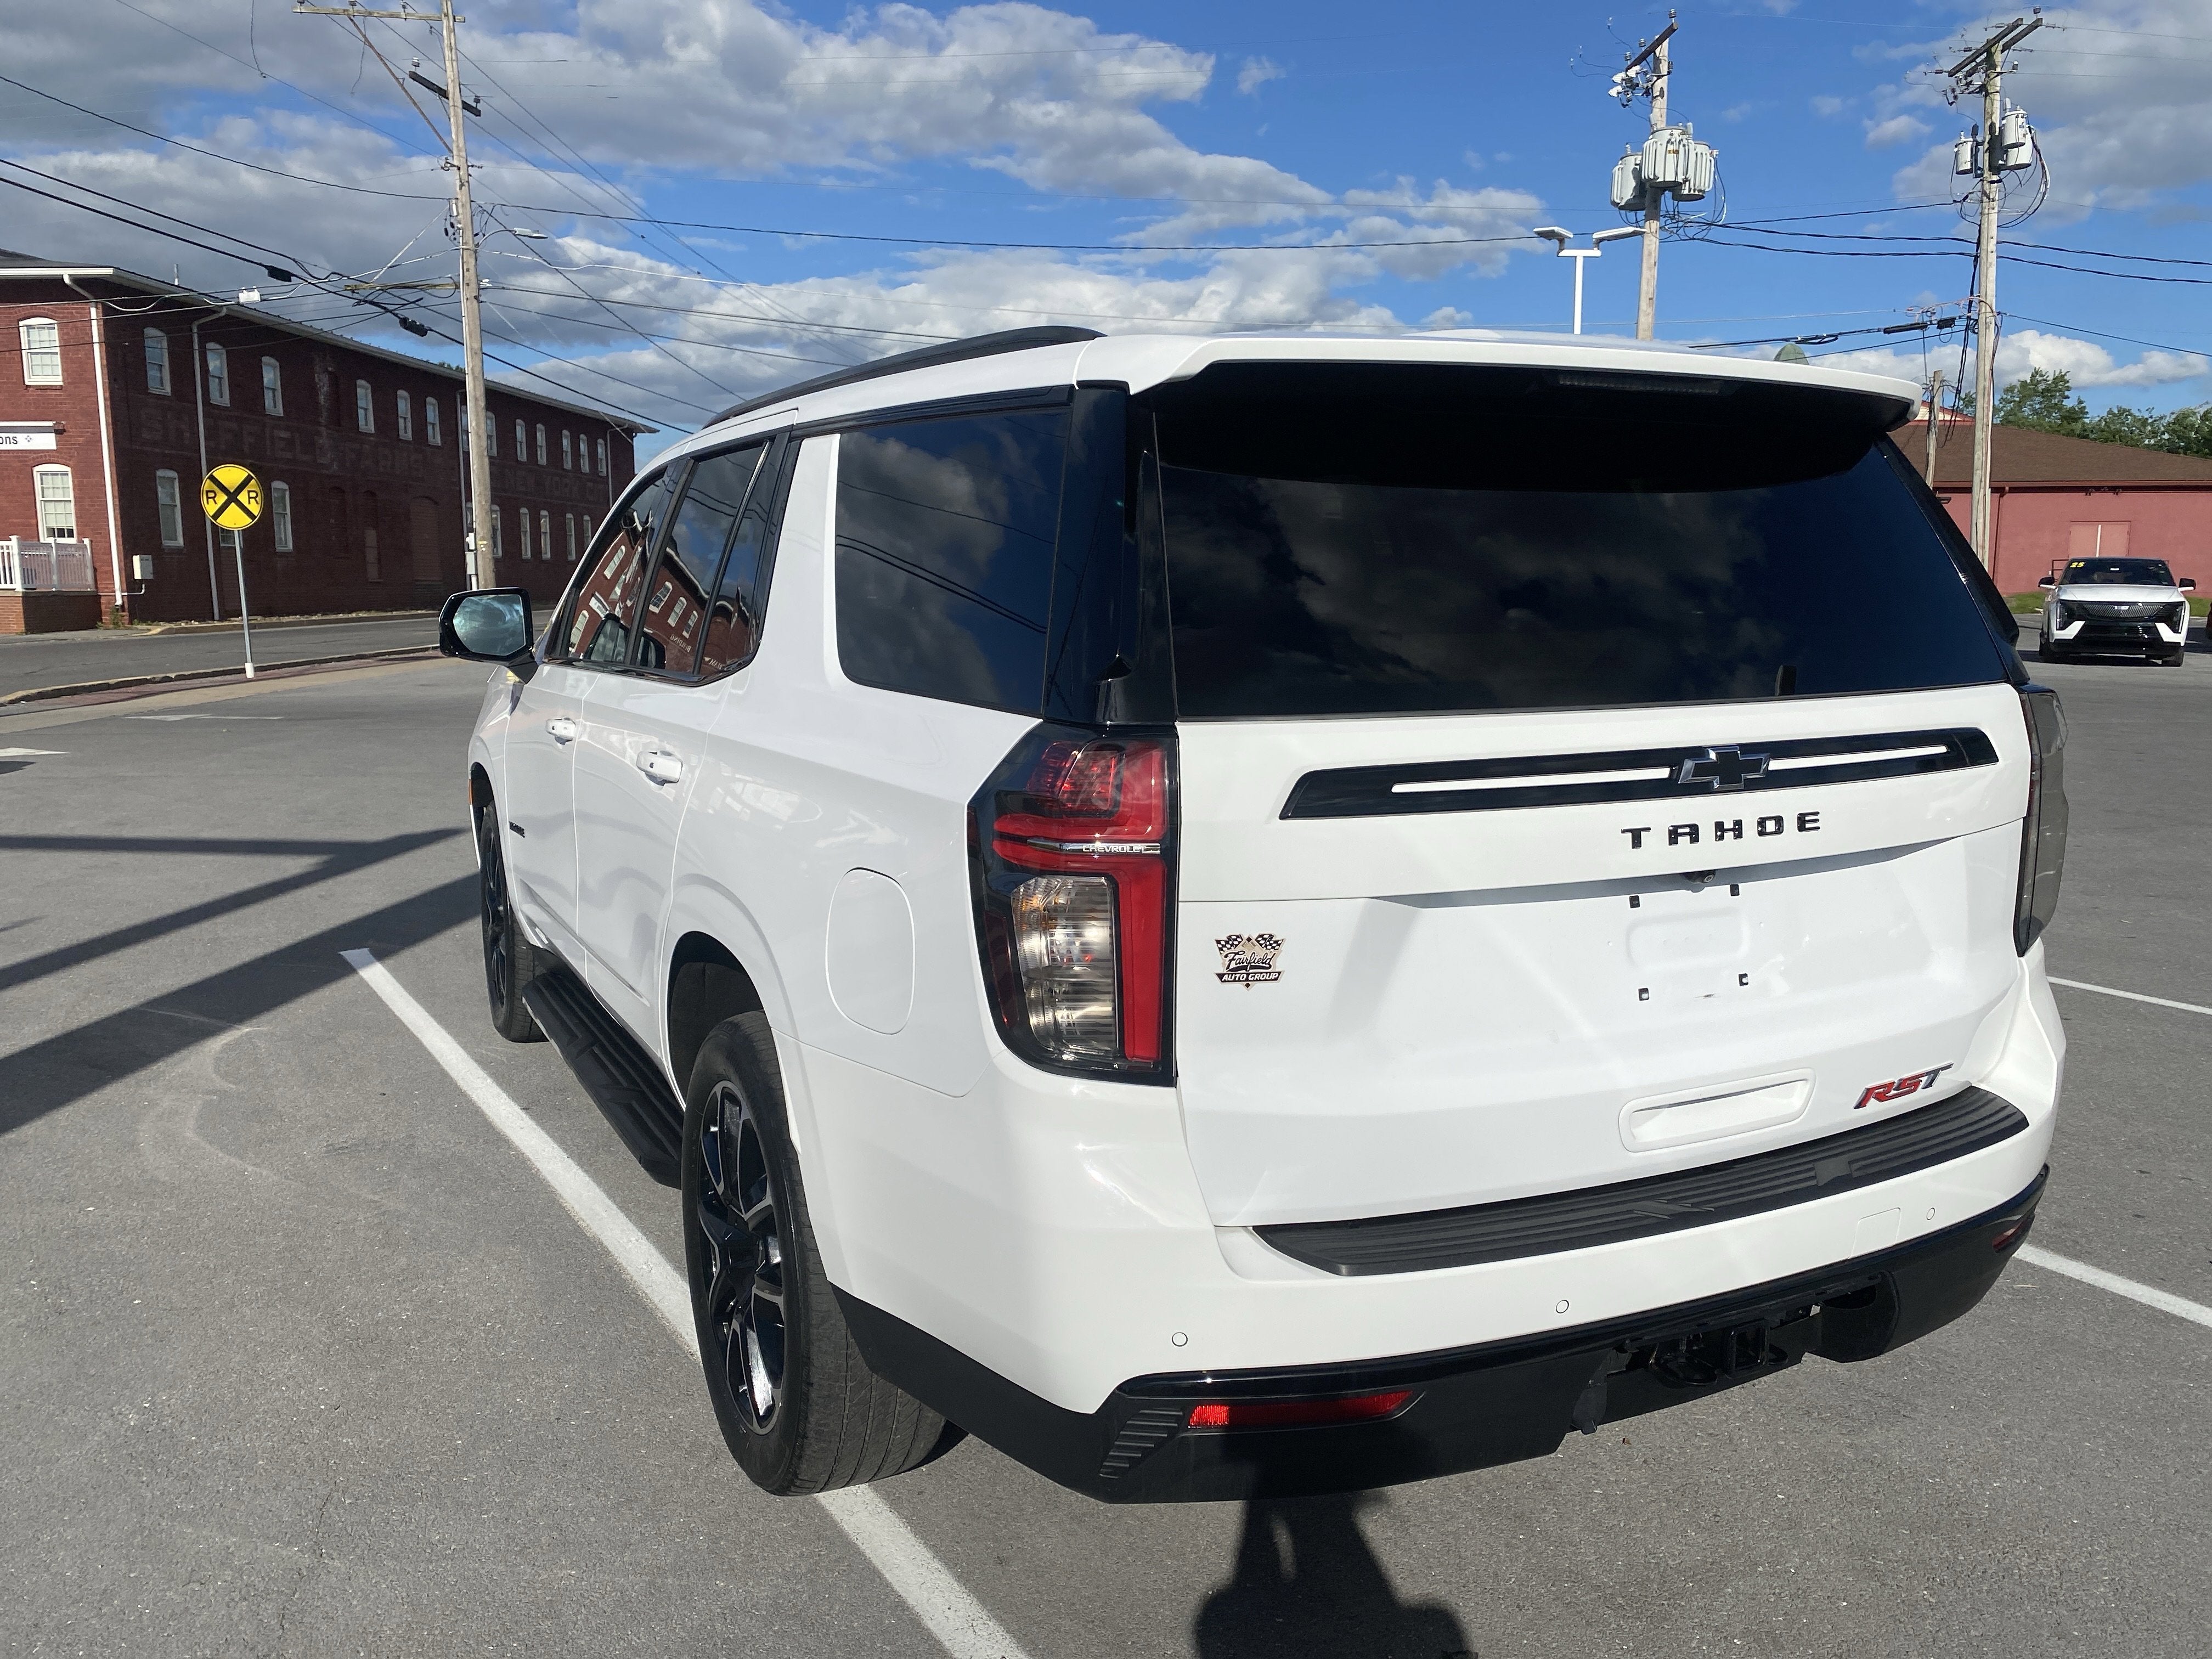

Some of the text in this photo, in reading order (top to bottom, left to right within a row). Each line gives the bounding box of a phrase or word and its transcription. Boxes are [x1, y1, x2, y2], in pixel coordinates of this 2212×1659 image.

[205, 490, 259, 505] R R
[1621, 811, 1821, 850] TAHOE
[1082, 845, 1147, 854] CHEVROLET
[1224, 950, 1276, 972] Fairfield
[1852, 1061, 1954, 1109] RST
